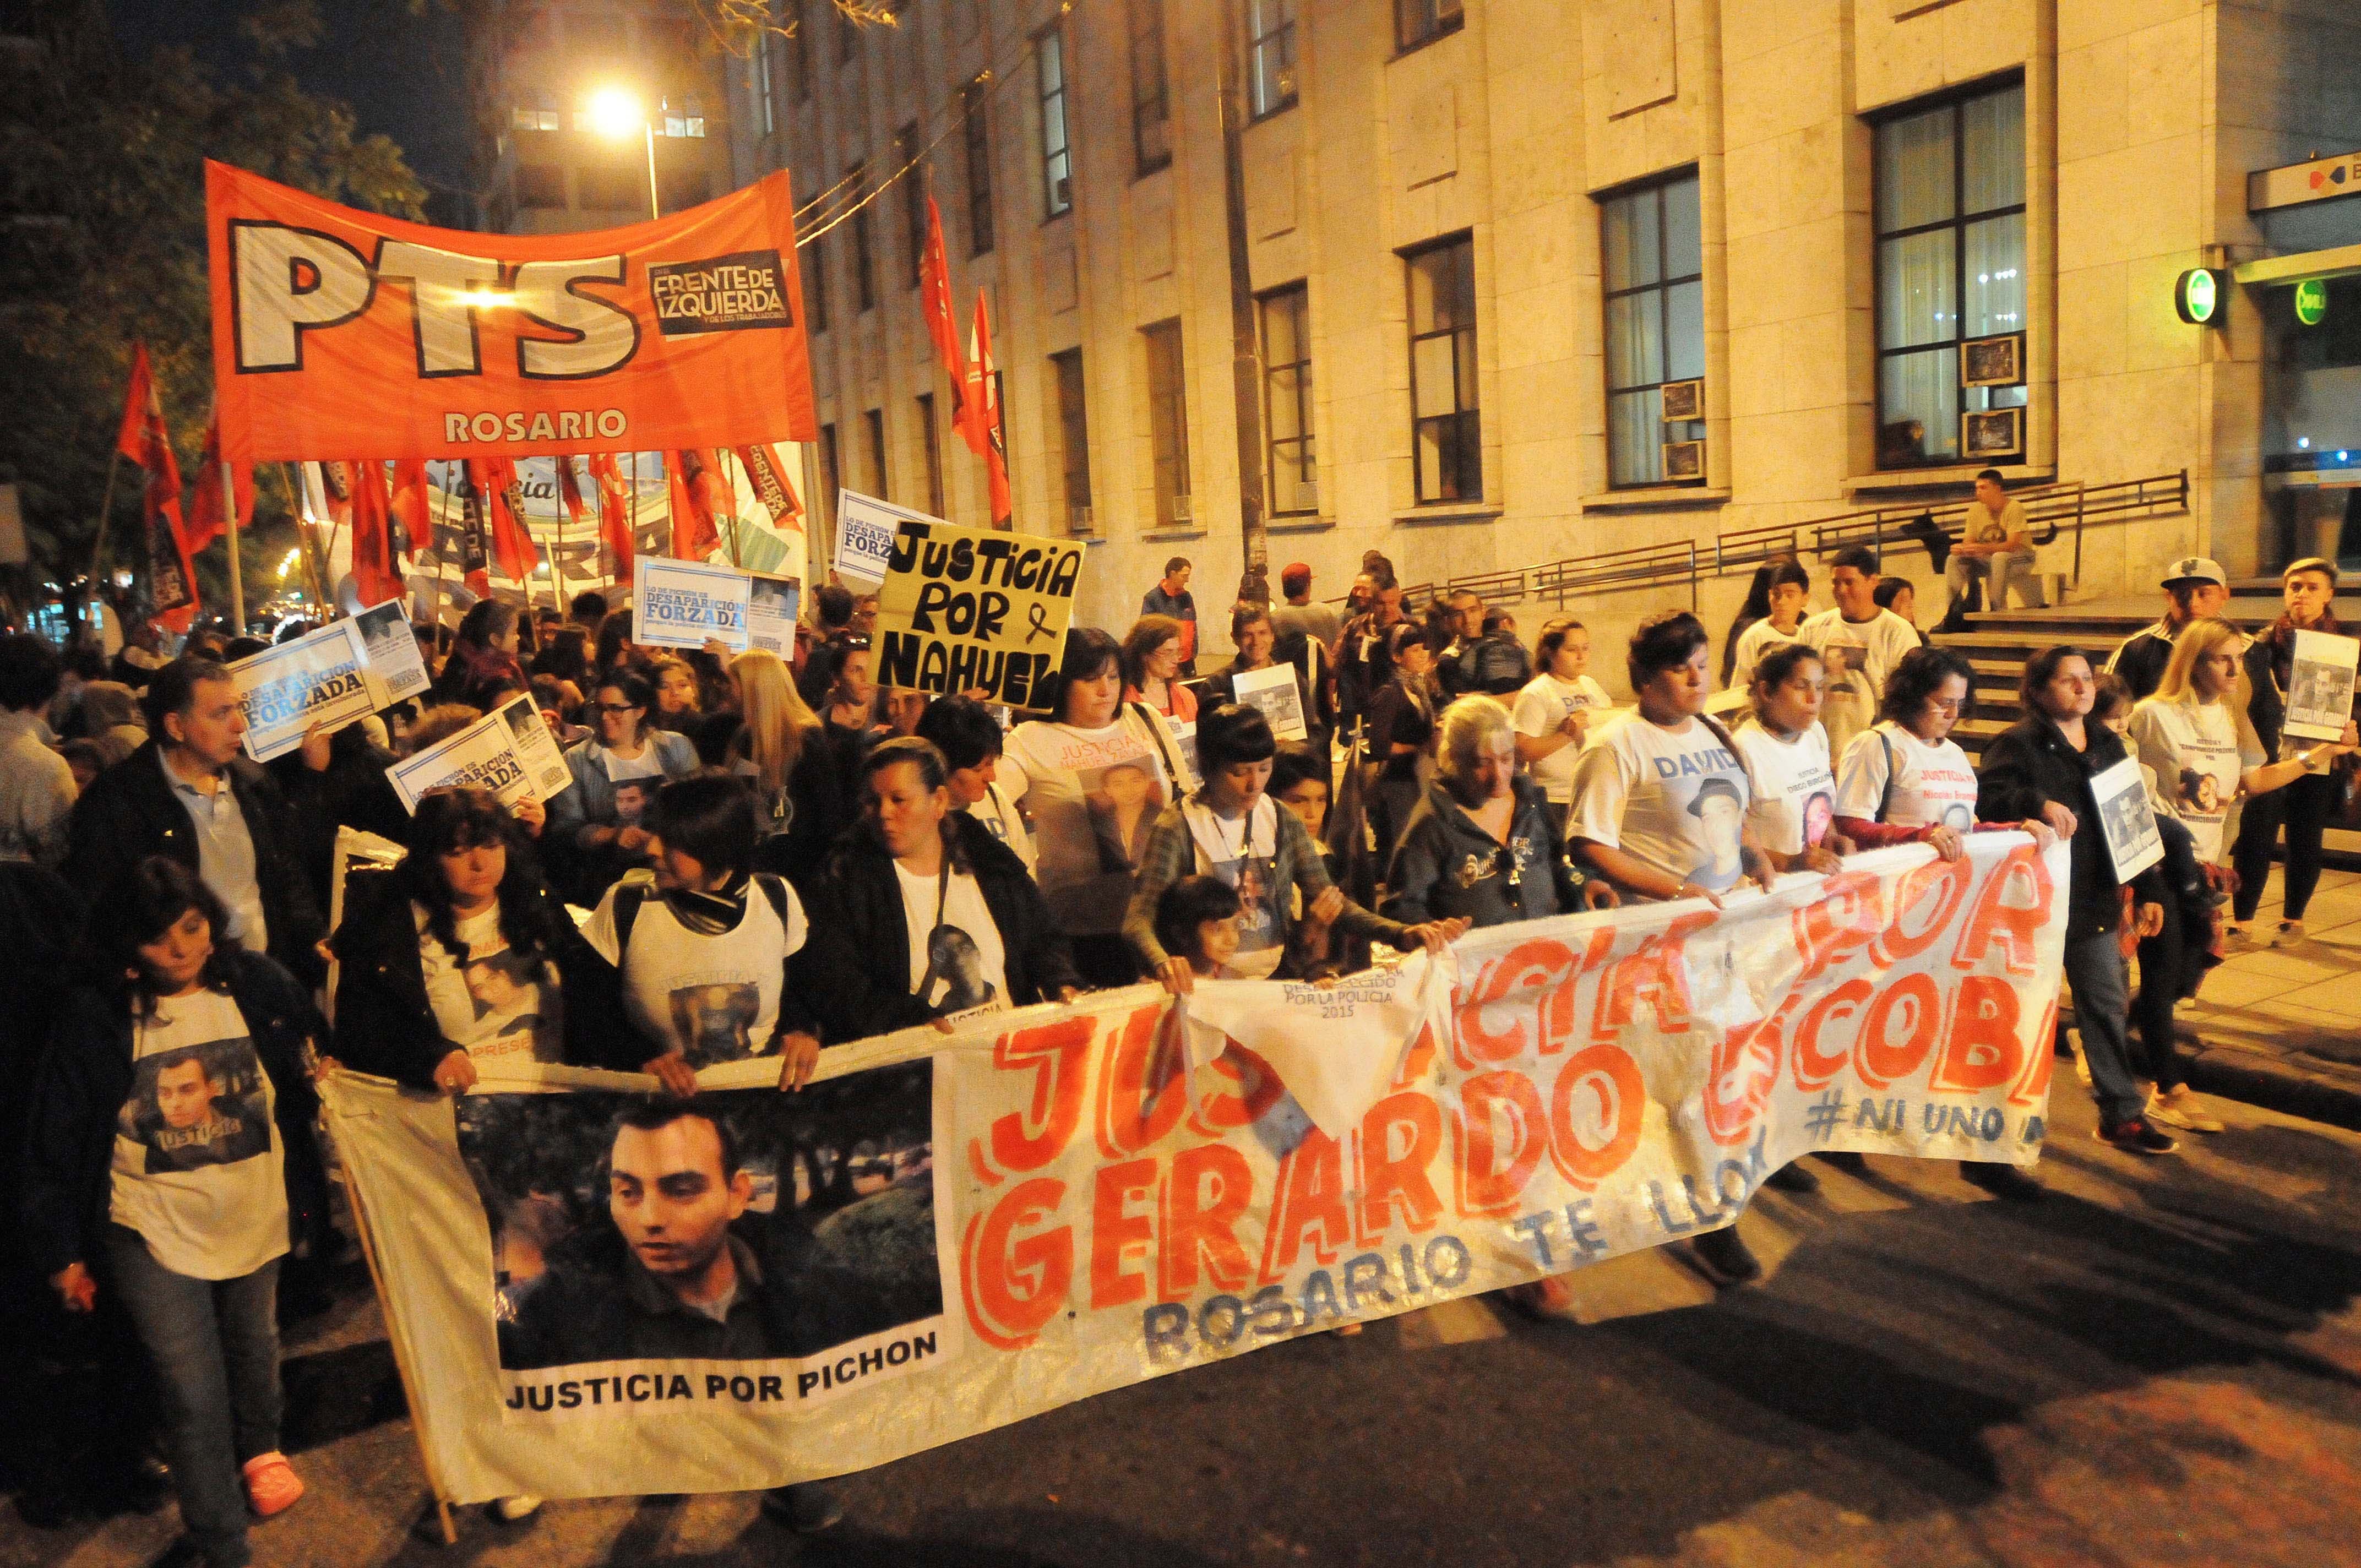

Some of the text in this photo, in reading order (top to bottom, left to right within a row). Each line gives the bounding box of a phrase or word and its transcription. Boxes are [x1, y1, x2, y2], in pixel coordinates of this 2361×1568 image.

[654, 266, 774, 297] FRENTE DE
[227, 217, 641, 381] PTS
[657, 288, 785, 318] IZQUIERDA
[443, 410, 629, 443] ROSARIO
[845, 532, 893, 558] FORZ
[846, 522, 892, 545] DESAPA
[887, 521, 1081, 597] JUSTICIA
[646, 603, 744, 627] FORZADA
[911, 582, 1010, 641] POR
[878, 631, 1060, 709] NAHUEL
[245, 673, 362, 729] FORZADA
[1062, 735, 1133, 760] JUSTICIA
[1653, 747, 1738, 778] DAVID
[1921, 770, 1965, 781] JUSTICIA
[1793, 842, 2053, 988] POR
[1286, 993, 1316, 1005] POR
[1319, 993, 1335, 1005] LA
[1322, 1004, 1354, 1019] 2015
[1925, 1103, 2004, 1142] UNO
[960, 1044, 1645, 1352] GERARDO
[1143, 1235, 1472, 1365] ROSARIO
[1511, 1197, 1608, 1267] TE
[505, 1331, 937, 1413] JUSTICIA POR PICHON
